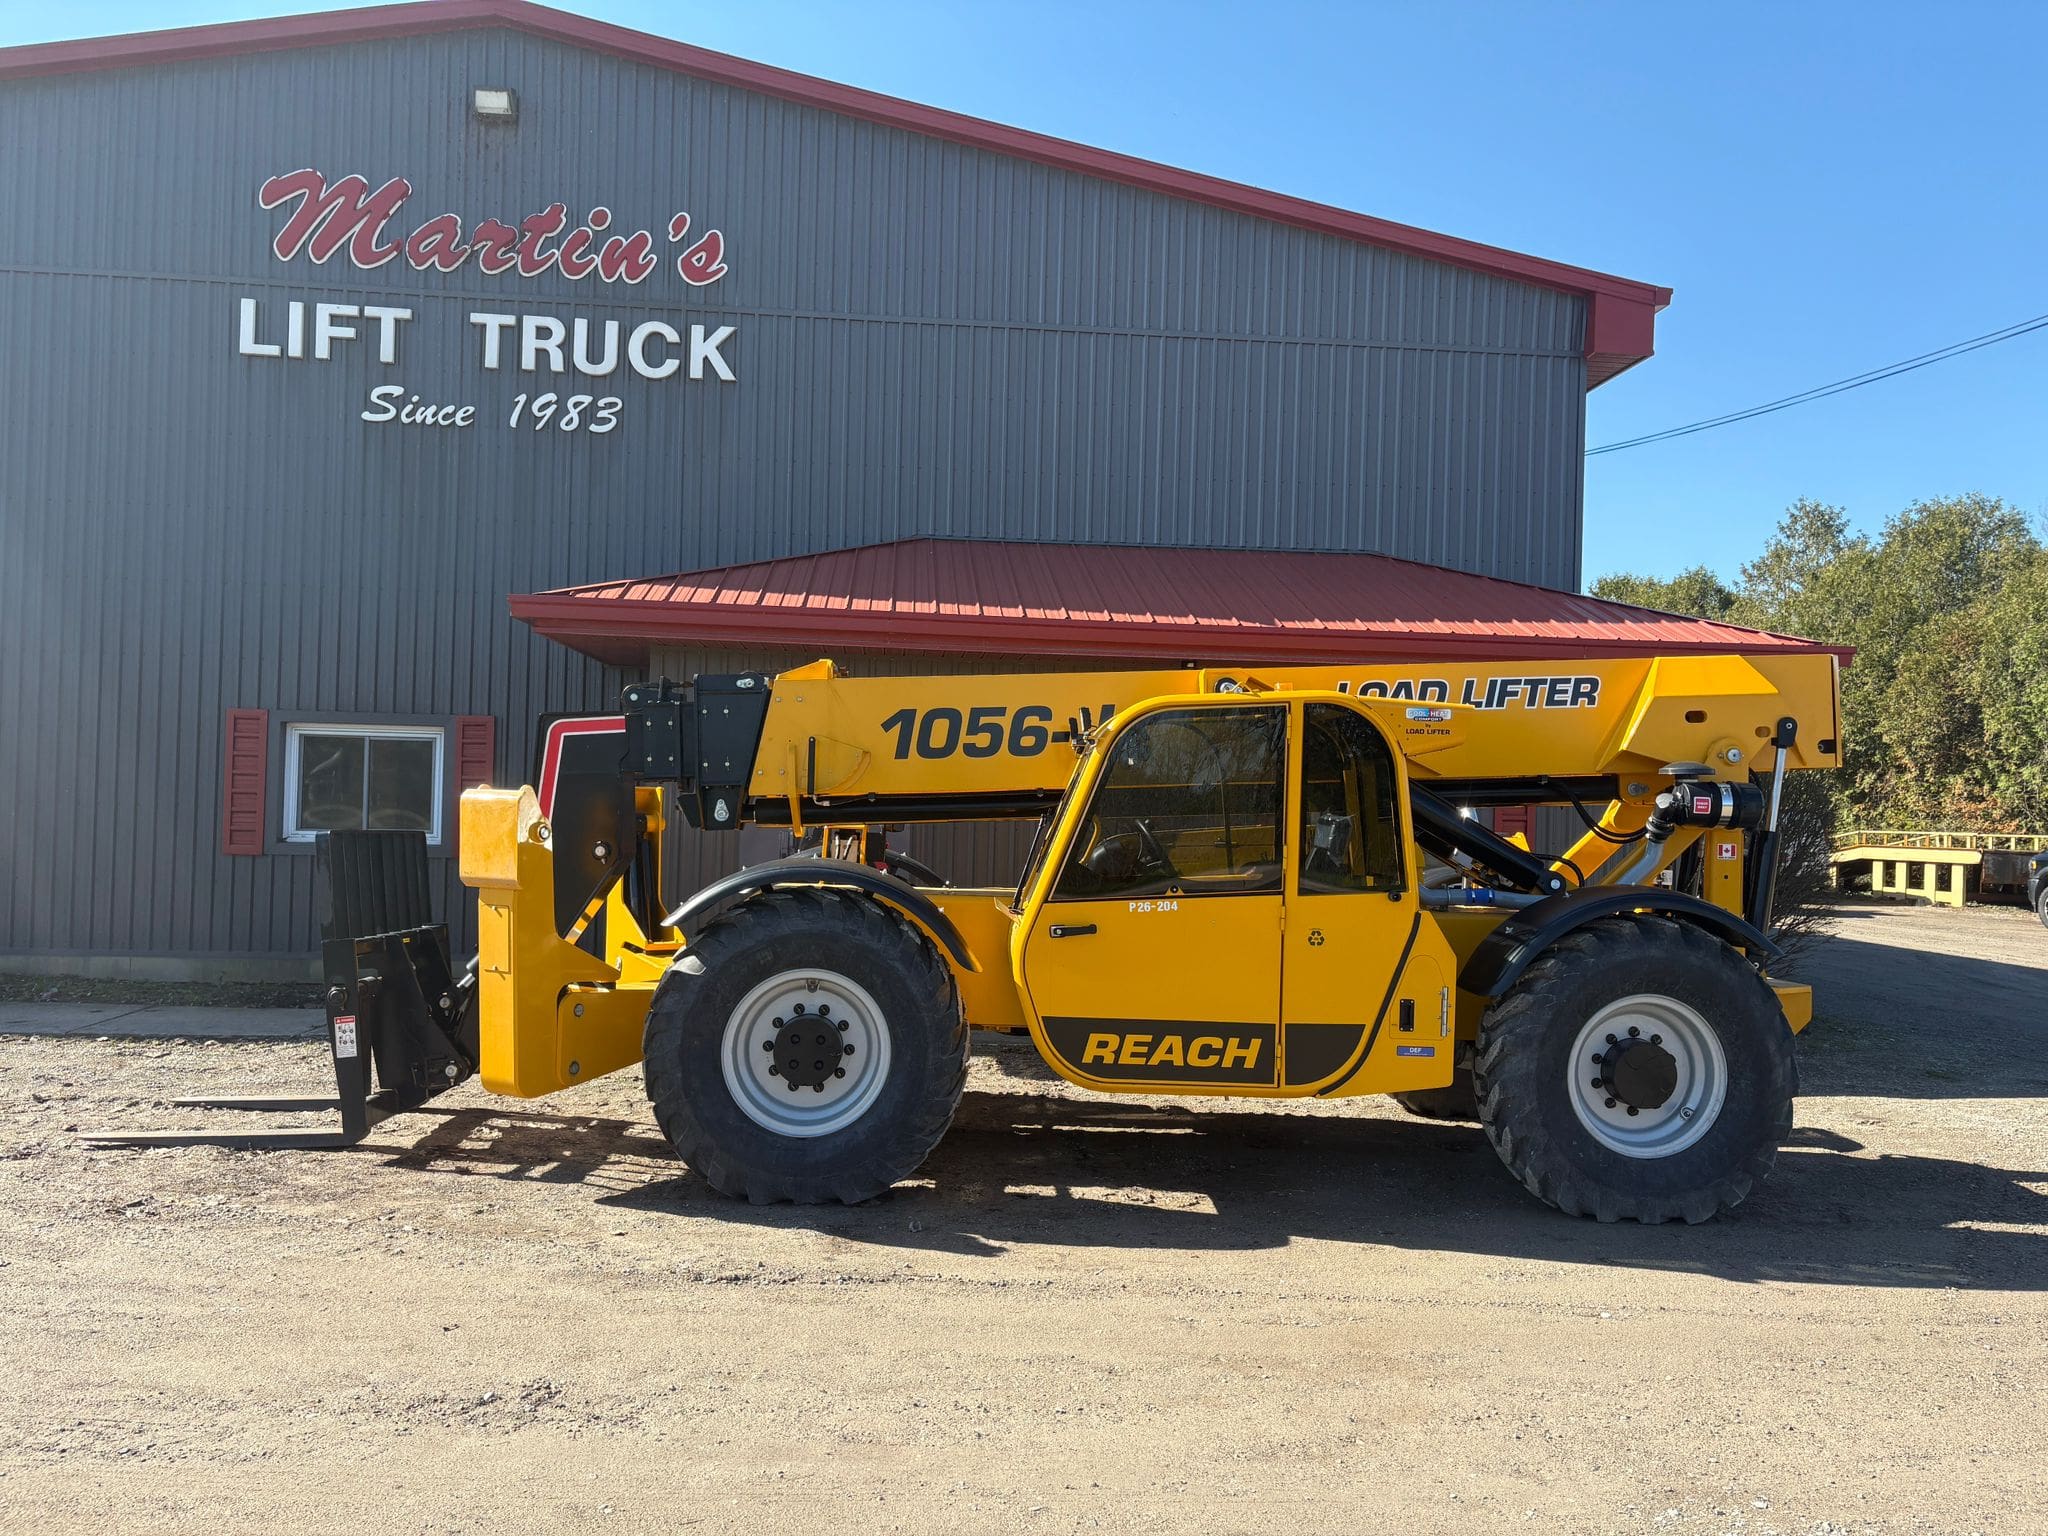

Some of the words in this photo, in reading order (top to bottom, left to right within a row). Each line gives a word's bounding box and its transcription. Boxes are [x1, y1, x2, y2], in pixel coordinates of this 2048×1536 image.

[259, 168, 728, 286] Martin's
[239, 298, 412, 364] LIFT
[470, 312, 737, 381] TRUCK
[361, 385, 475, 427] Since
[509, 392, 623, 433] 1983
[1461, 675, 1601, 710] LIFTER
[1081, 1033, 1263, 1069] REACH
